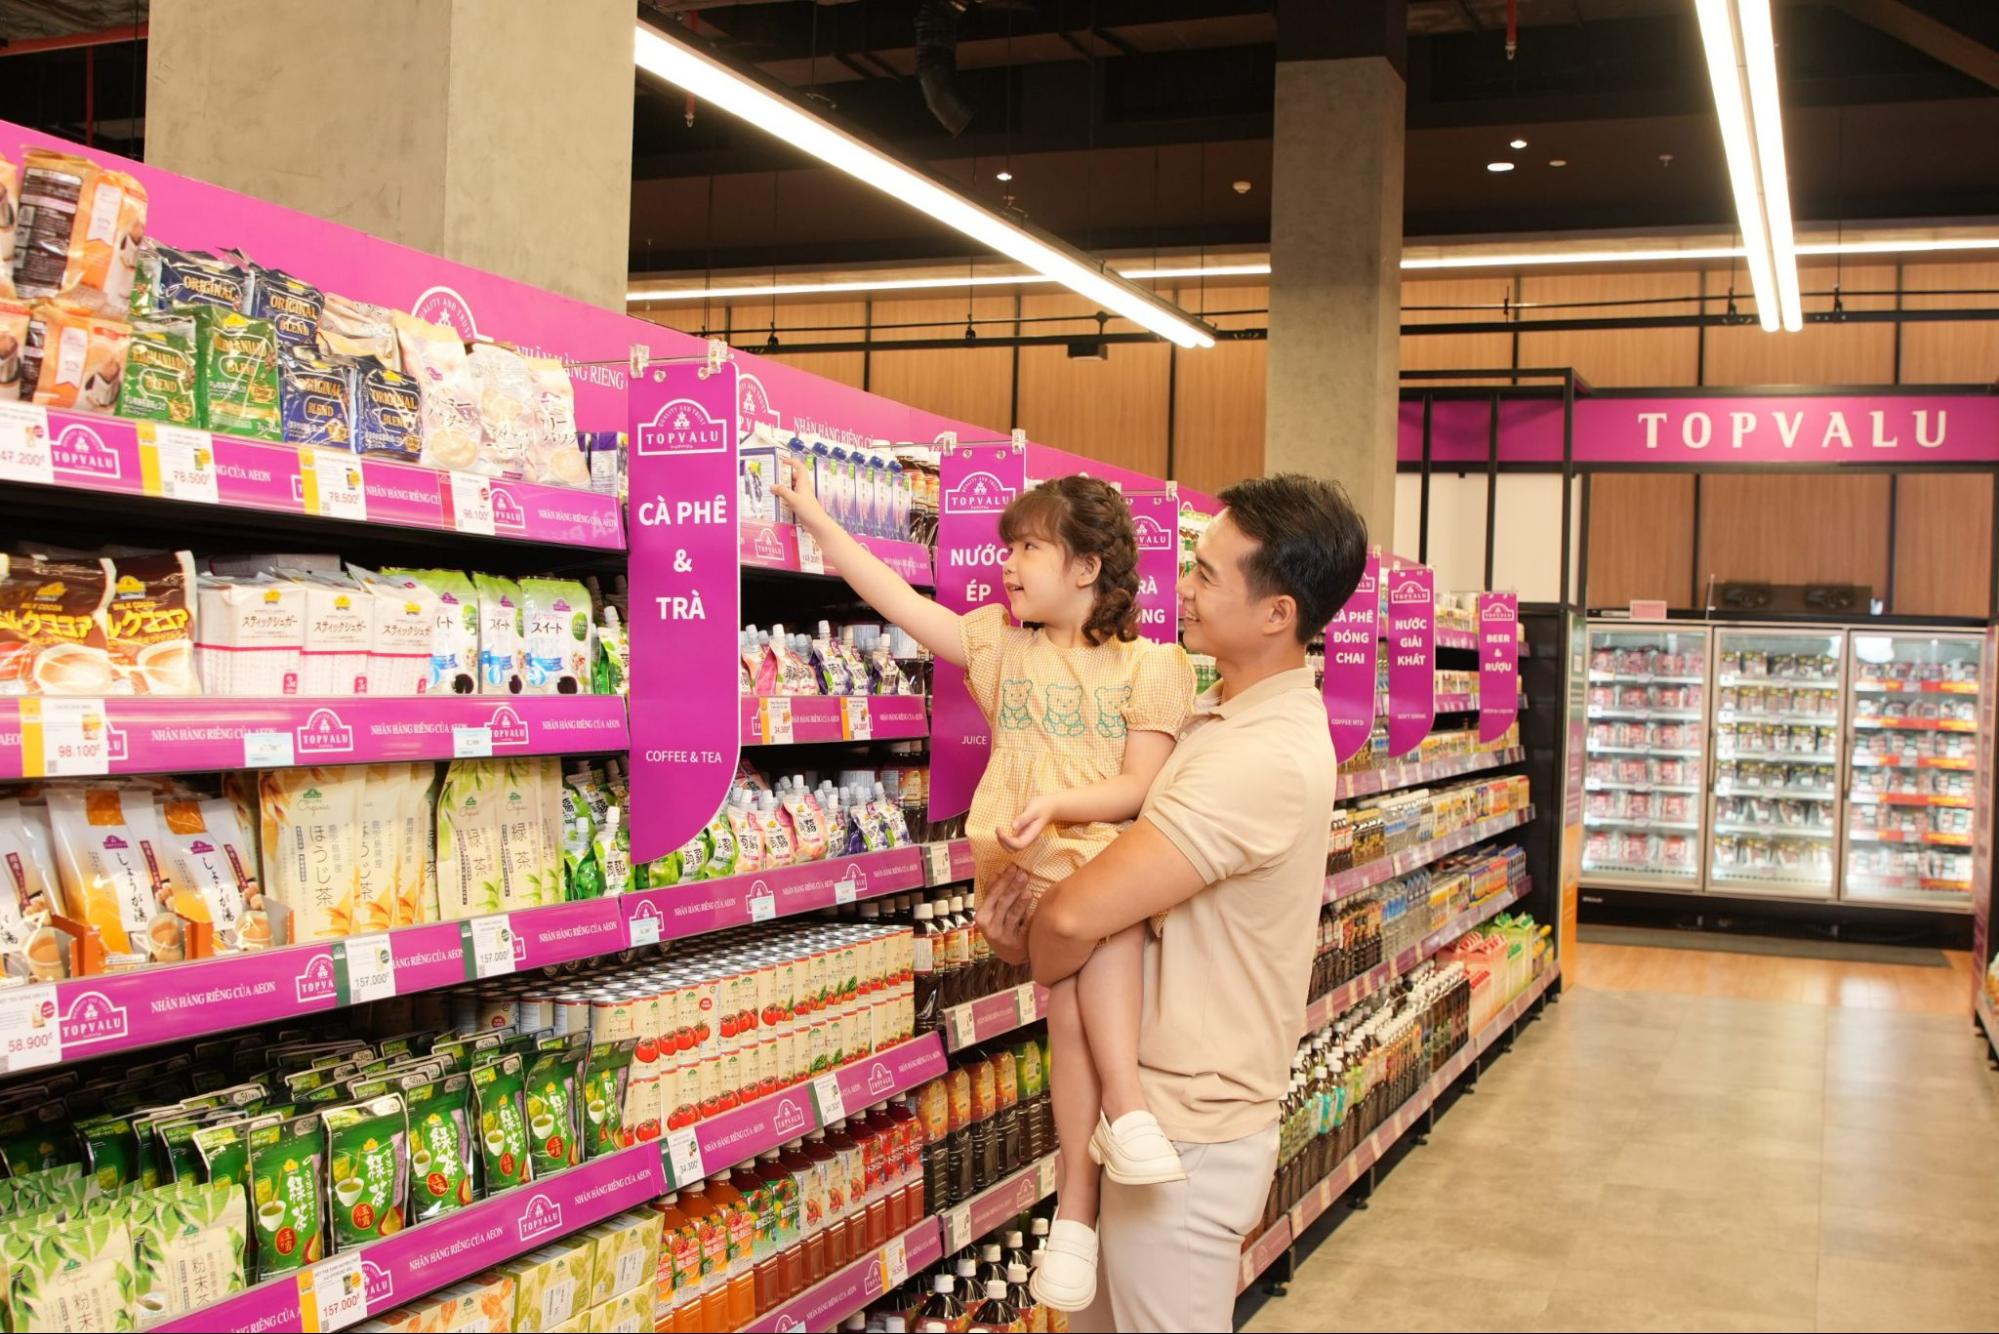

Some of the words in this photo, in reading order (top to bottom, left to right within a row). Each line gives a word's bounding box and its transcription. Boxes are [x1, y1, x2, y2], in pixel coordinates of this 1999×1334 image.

[590, 364, 624, 390] RIÊNG
[646, 430, 719, 445] TOPVALU
[1638, 410, 1947, 449] TOPVALU
[53, 450, 113, 469] TOPVALU
[951, 495, 1010, 506] TOPVALU
[638, 495, 671, 526] CÀ
[677, 494, 728, 524] PHÊ
[672, 549, 693, 573] &
[966, 579, 992, 602] ÉP
[1138, 575, 1158, 595] RÀ
[656, 590, 706, 621] TRÀ
[1348, 608, 1374, 623] PHÊ
[383, 624, 432, 637] スティックシュガ
[530, 621, 563, 634] スイート
[1333, 629, 1370, 644] ĐÓNG
[1336, 652, 1365, 664] CHAI
[151, 727, 179, 742] NHÃN
[179, 727, 207, 741] HÀNG
[207, 725, 234, 741] RIÊNG
[302, 734, 349, 744] TOPVALU
[961, 735, 988, 745] JUICE
[646, 748, 687, 763] COFFEE
[689, 749, 699, 763] &
[701, 749, 722, 764] TEA
[301, 980, 335, 993] TOPVA
[151, 999, 179, 1014] NHÃN
[178, 994, 206, 1009] HÀNG
[206, 987, 232, 1004] RIÊNG
[232, 983, 252, 999] CỦA
[252, 980, 277, 996] AEON
[62, 1017, 121, 1038] TOPVALU
[522, 1213, 558, 1233] TOPVALU
[450, 1239, 472, 1257] RIÊNG
[485, 1225, 504, 1242] AEON
